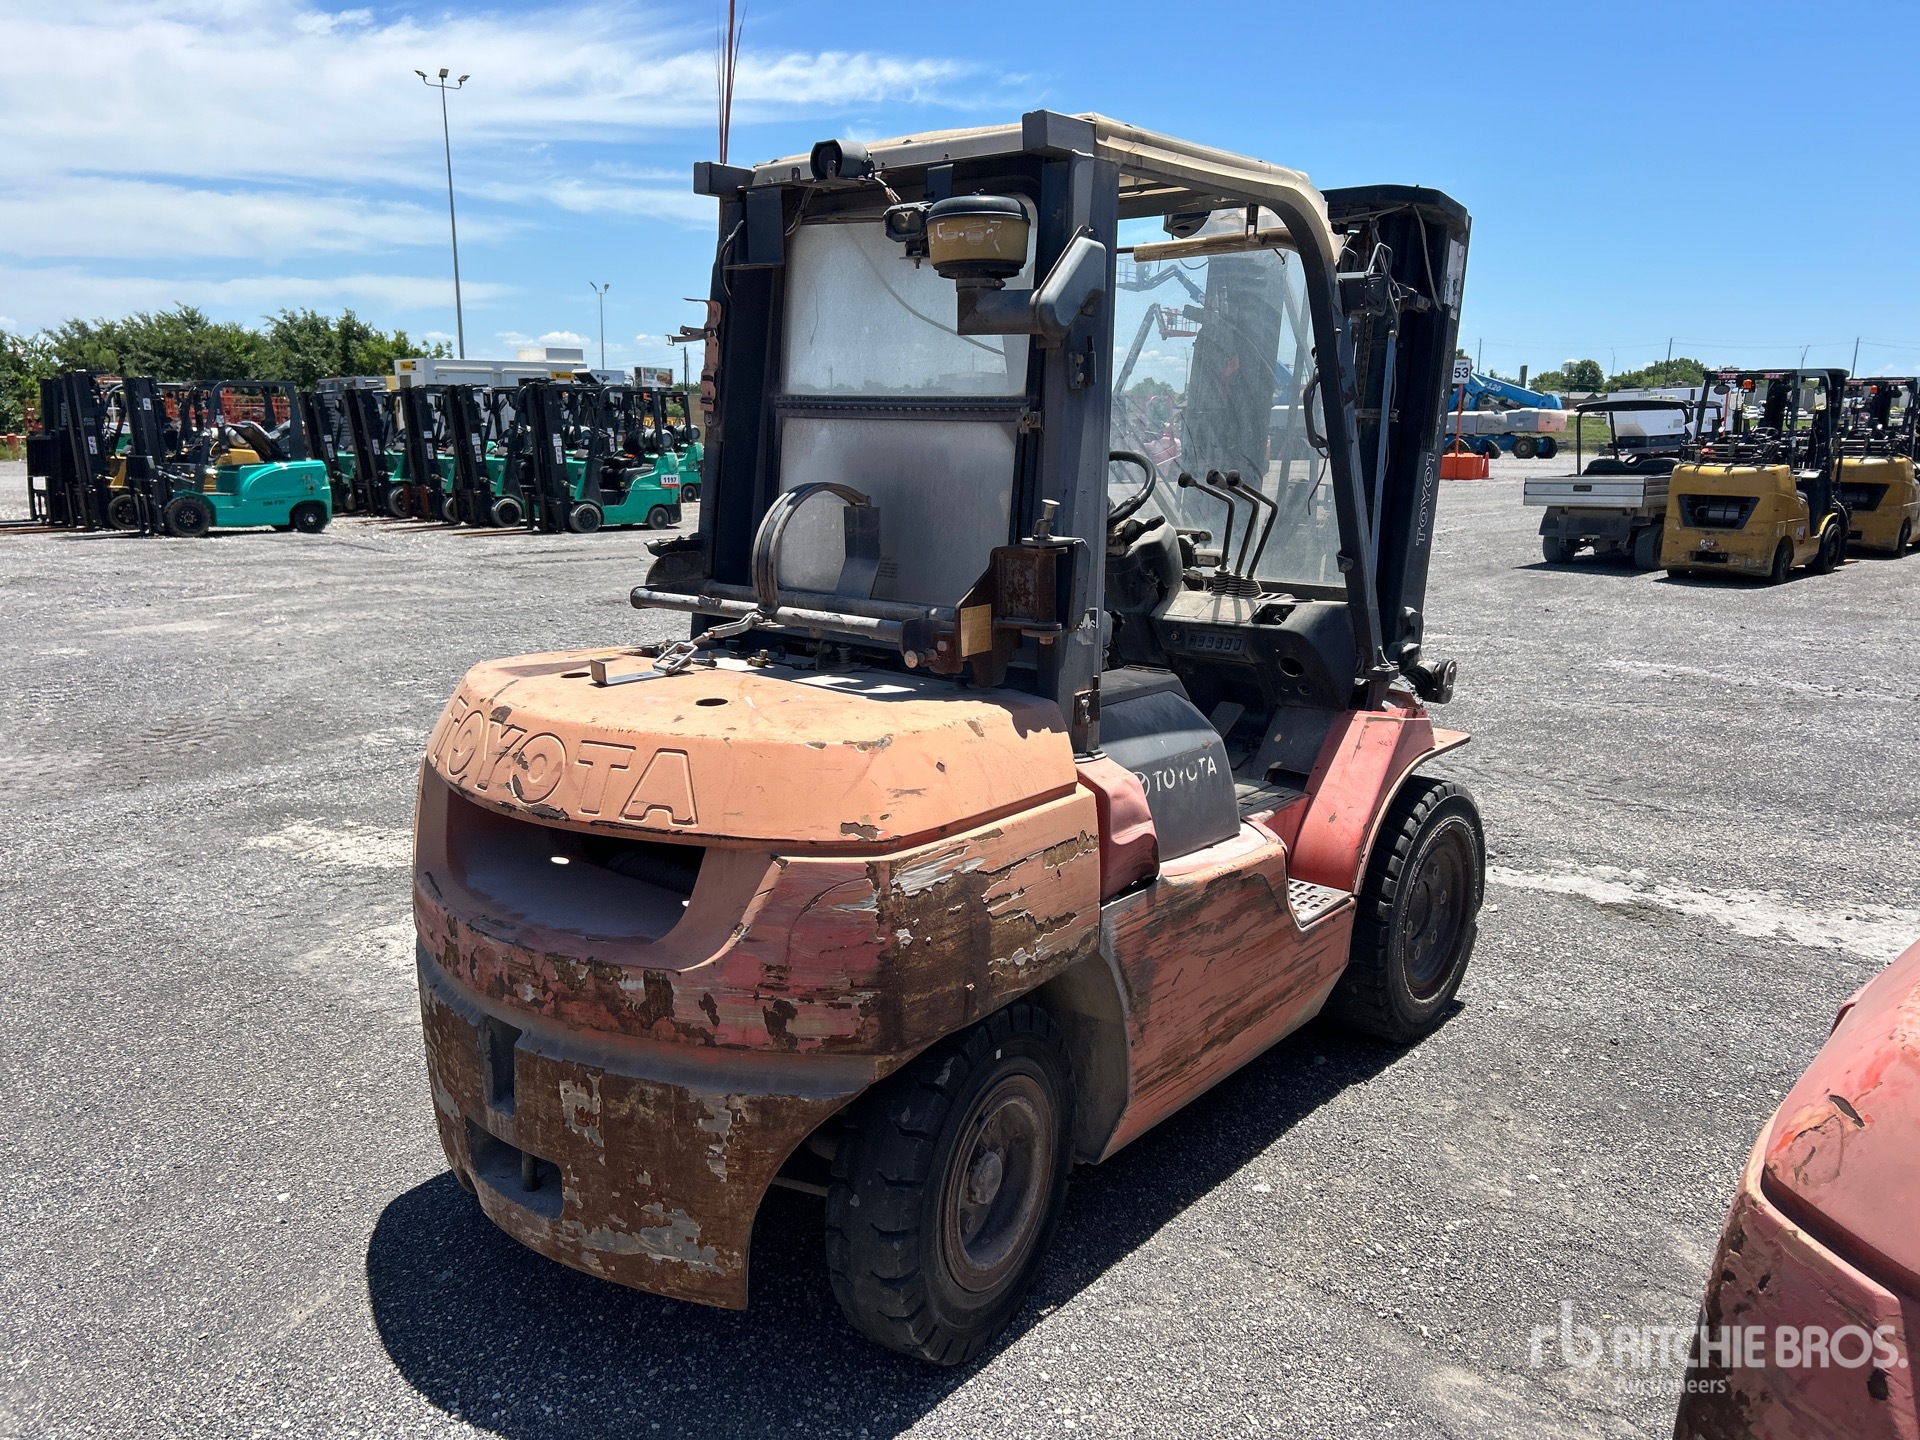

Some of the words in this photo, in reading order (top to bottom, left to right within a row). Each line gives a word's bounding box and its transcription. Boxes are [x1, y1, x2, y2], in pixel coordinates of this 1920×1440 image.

[1454, 367, 1469, 379] 53
[1416, 427, 1440, 546] TOYOT
[431, 694, 699, 828] TOYOTA
[1152, 756, 1217, 792] TOYOTA
